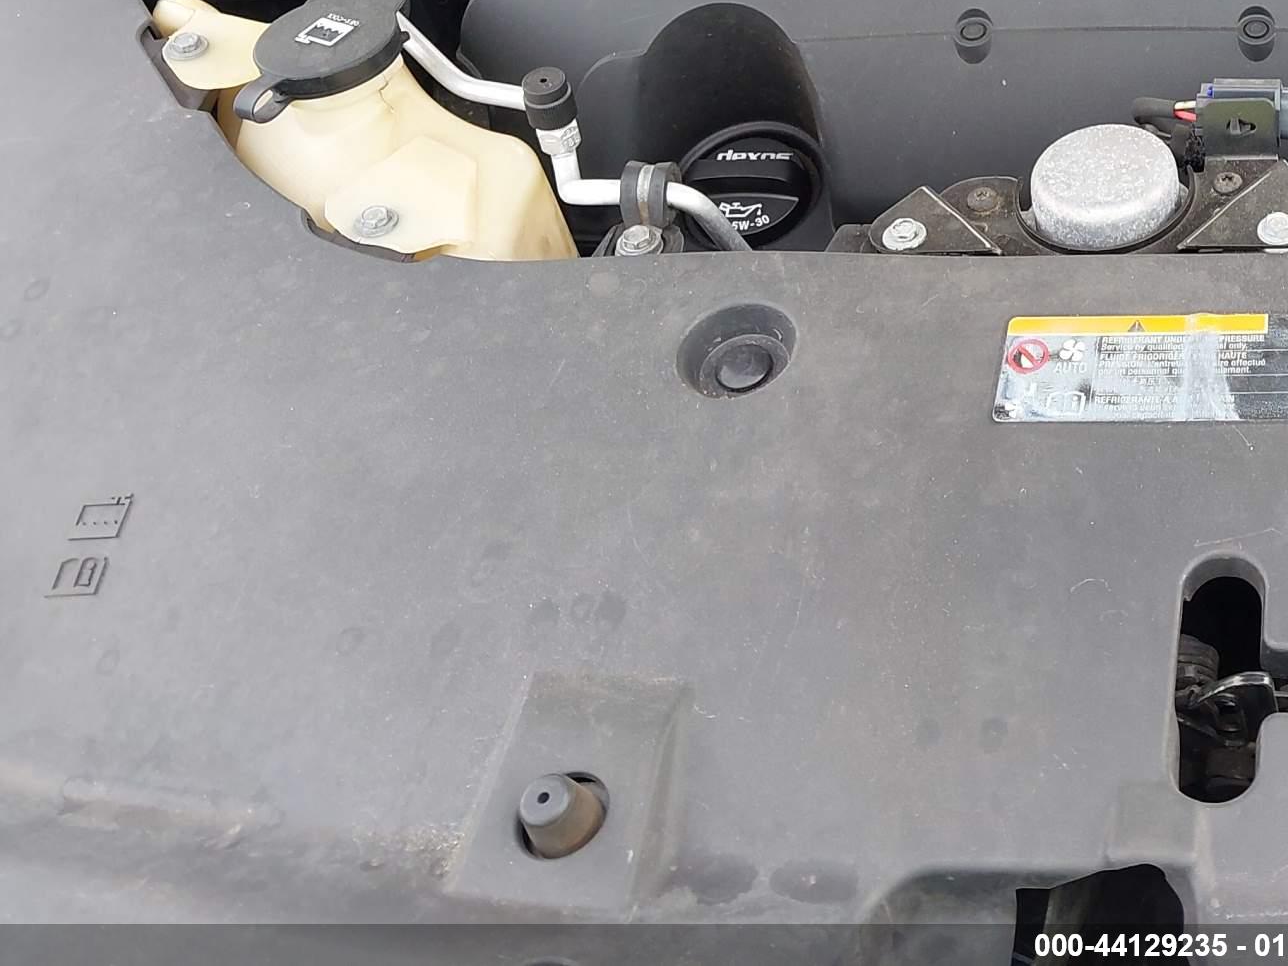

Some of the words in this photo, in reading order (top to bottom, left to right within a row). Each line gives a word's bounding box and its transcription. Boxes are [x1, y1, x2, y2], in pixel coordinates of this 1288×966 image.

[731, 214, 770, 231] 5W-30
[1218, 334, 1265, 343] PRESSURE
[1053, 361, 1087, 375] AUTO
